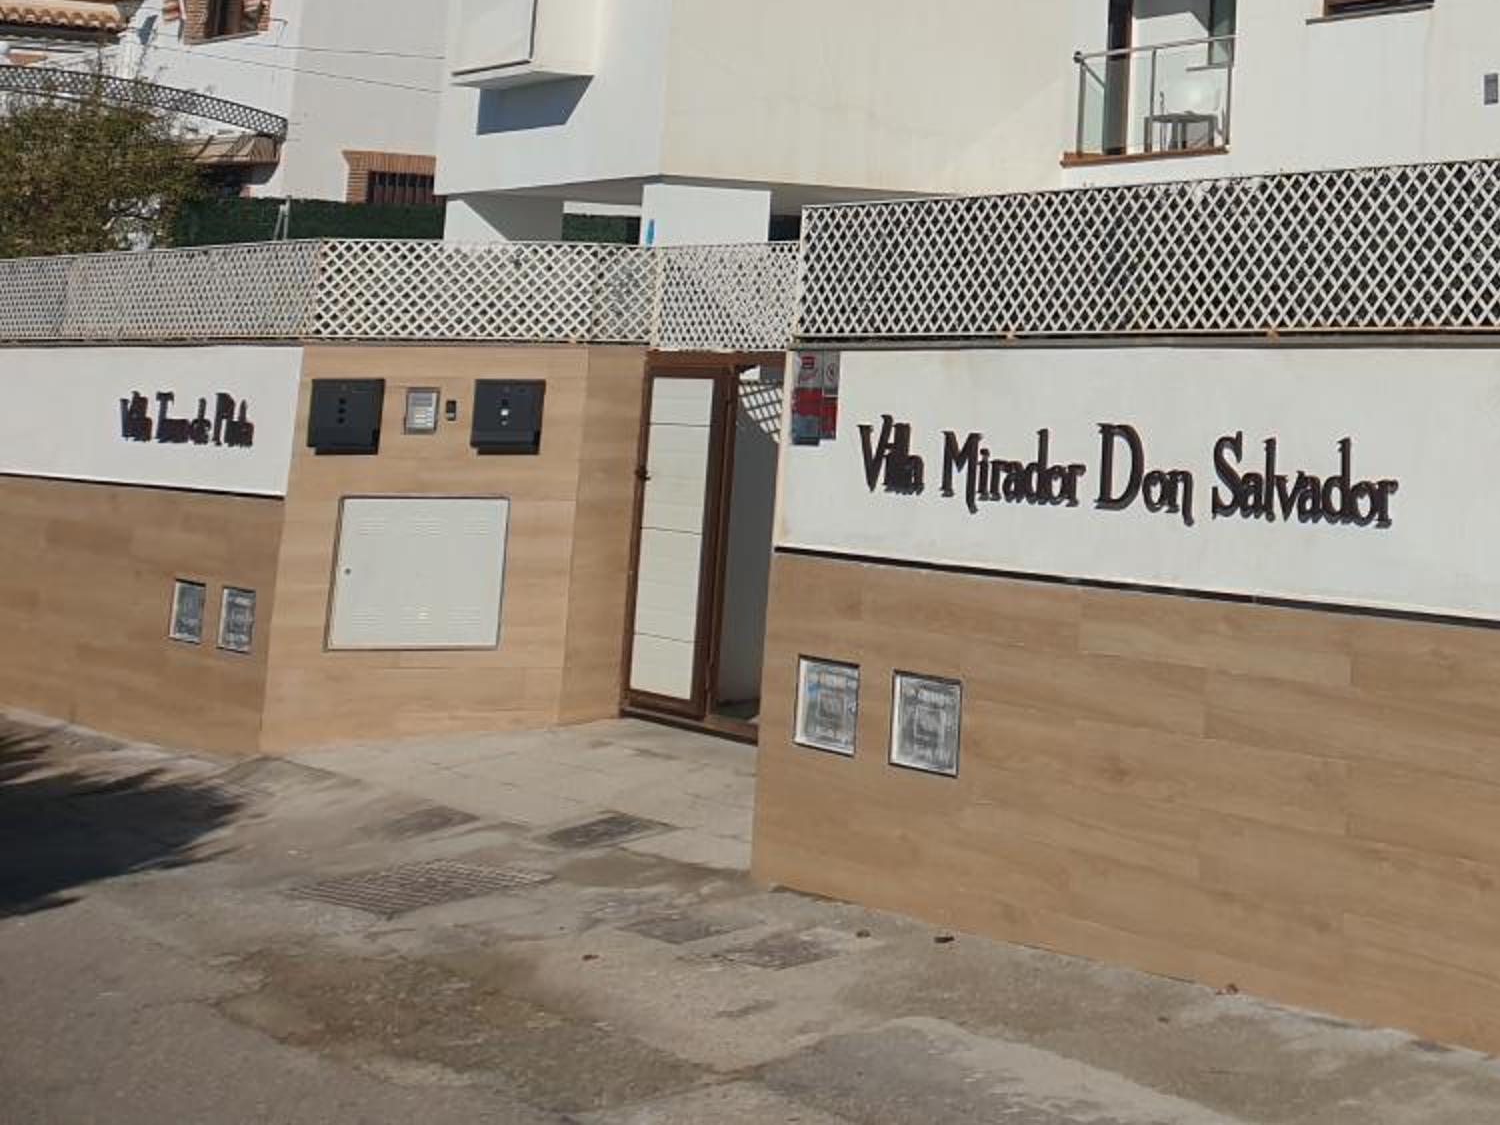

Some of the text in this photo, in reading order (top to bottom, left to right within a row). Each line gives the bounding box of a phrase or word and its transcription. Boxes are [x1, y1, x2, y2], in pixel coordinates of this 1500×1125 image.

[939, 428, 1087, 515] Mirador
[1093, 422, 1195, 527] Don
[1211, 430, 1399, 529] Salvador
